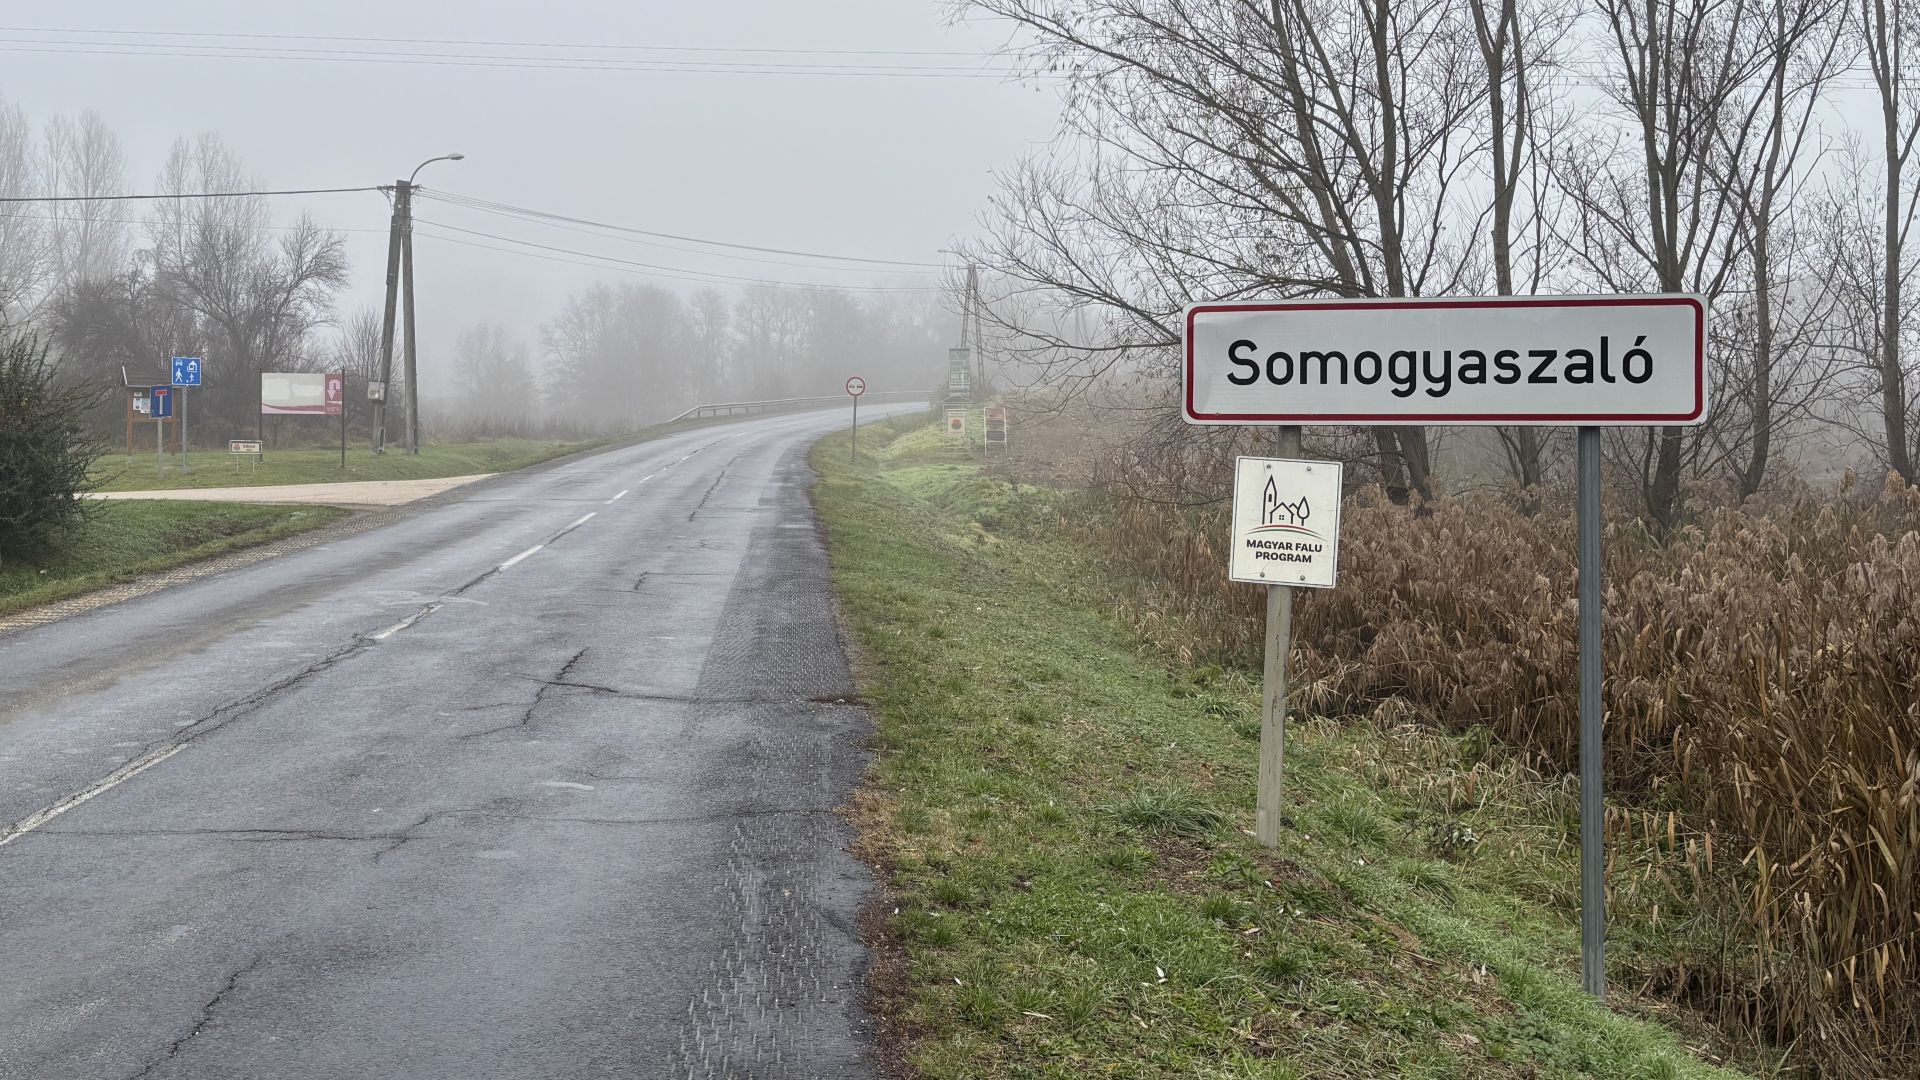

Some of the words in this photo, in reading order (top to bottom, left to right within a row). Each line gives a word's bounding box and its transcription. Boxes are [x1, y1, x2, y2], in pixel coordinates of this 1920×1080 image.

[1226, 335, 1654, 398] Somogyaszaló
[1246, 539, 1292, 550] MAGYAR
[1295, 543, 1322, 552] FALU
[1255, 551, 1312, 563] PROGRAM
